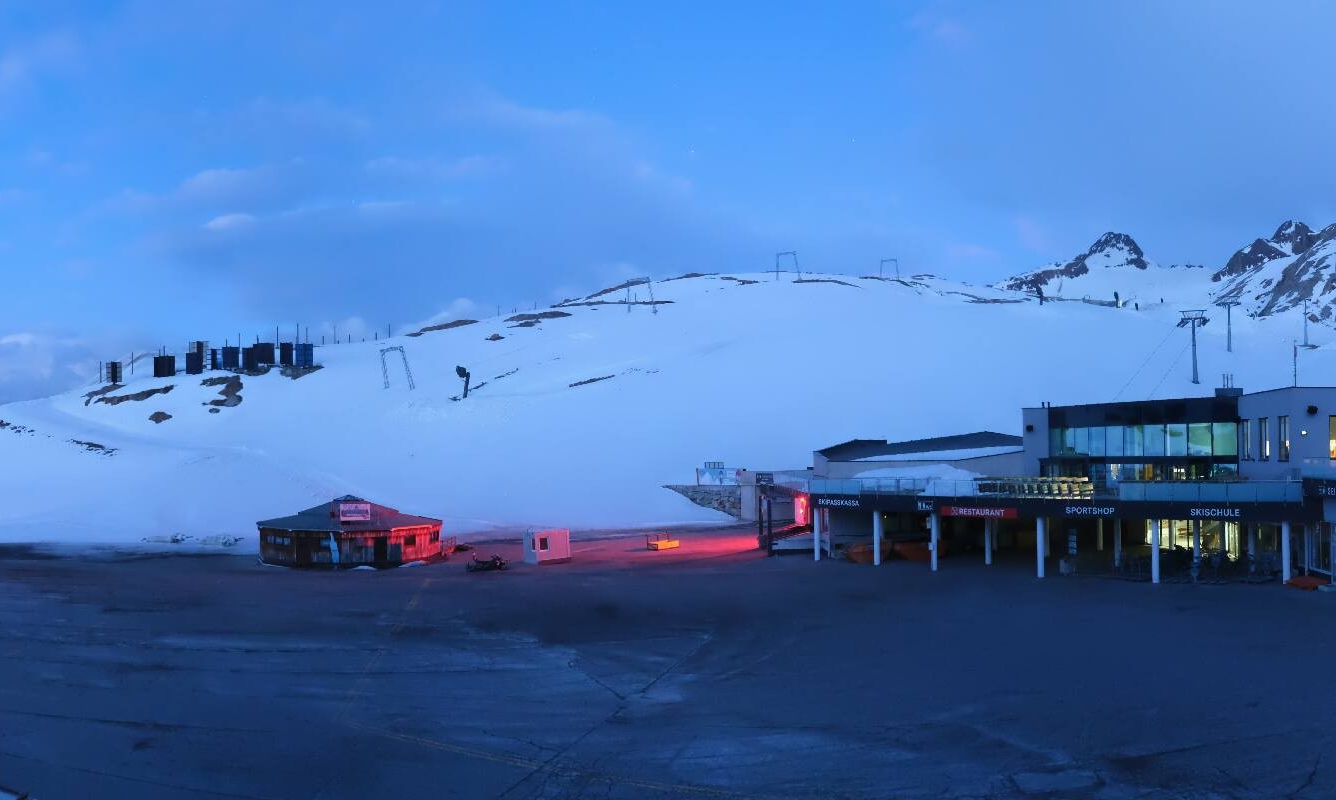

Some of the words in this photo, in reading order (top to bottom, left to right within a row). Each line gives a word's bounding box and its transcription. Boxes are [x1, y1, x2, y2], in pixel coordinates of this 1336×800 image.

[818, 498, 860, 507] SKIPASSKASSA
[959, 507, 1005, 518] RESTAURANT
[1065, 506, 1115, 515] SPORTSHOP
[1190, 508, 1240, 518] SKISCHULE
